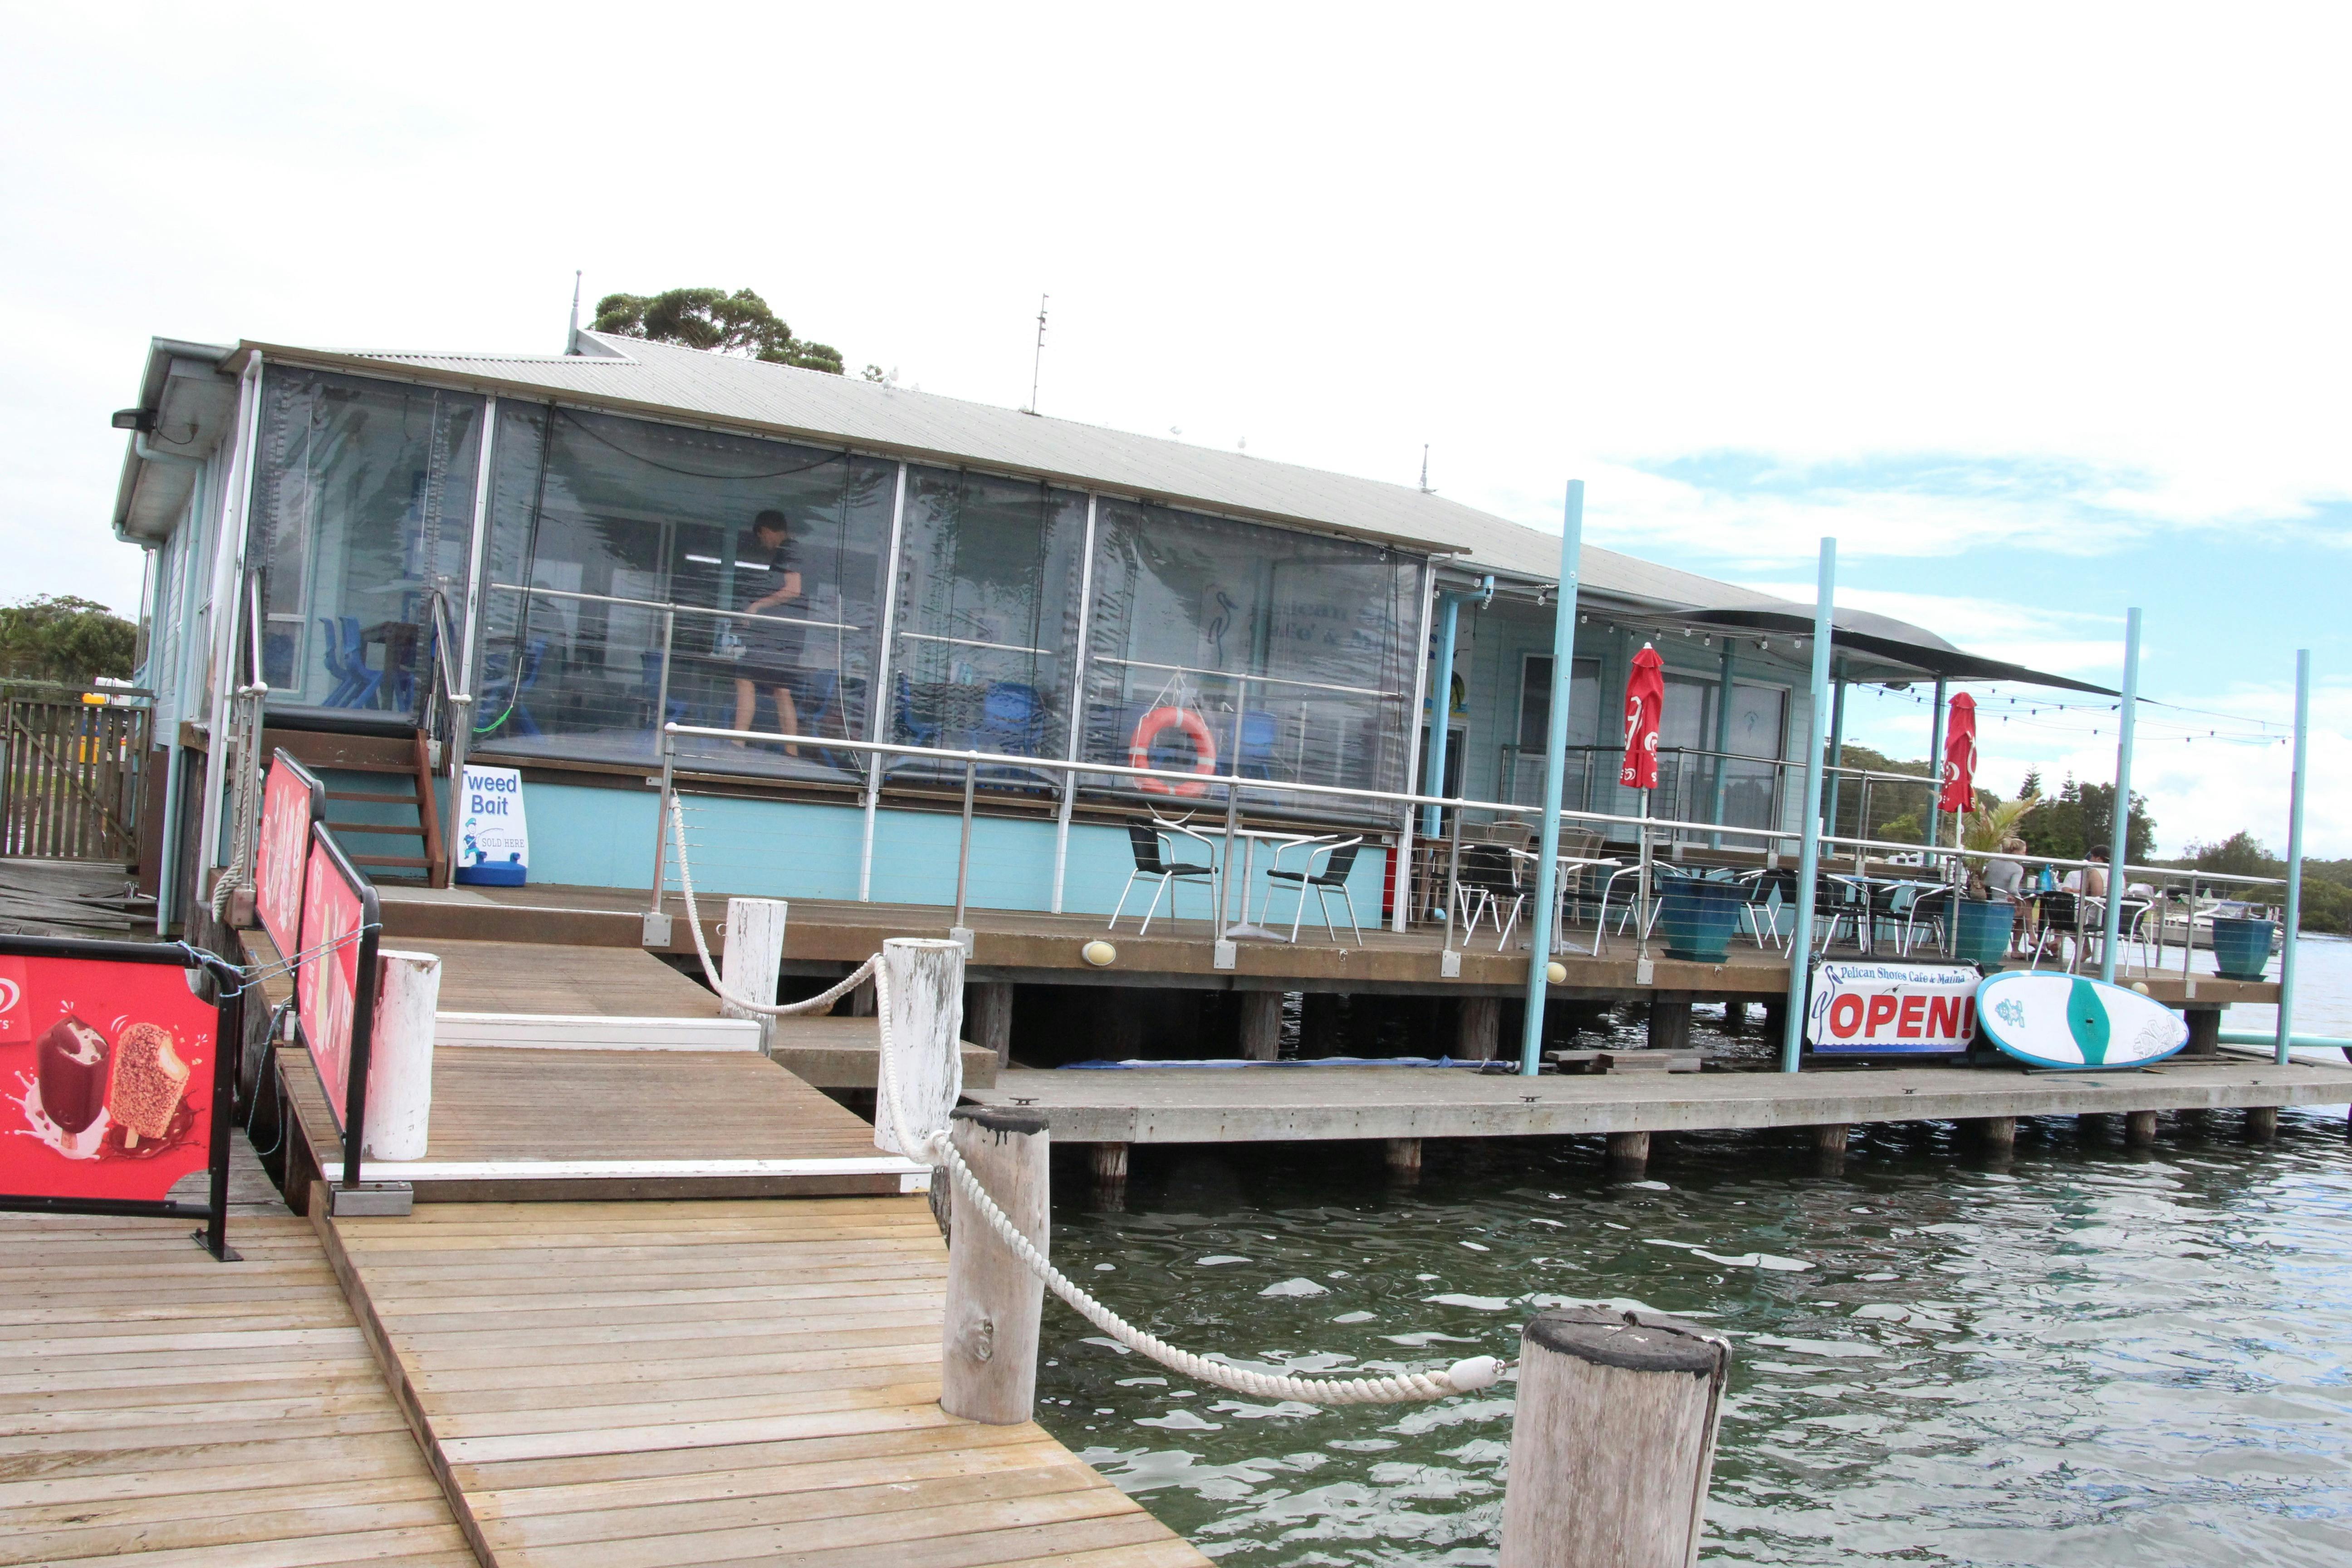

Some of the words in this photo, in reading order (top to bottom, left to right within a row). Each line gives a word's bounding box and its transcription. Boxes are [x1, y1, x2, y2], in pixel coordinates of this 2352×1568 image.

[471, 794, 508, 815] Bait
[482, 838, 501, 847] SOLD
[505, 839, 525, 848] HERE
[1840, 966, 1875, 979] Pelican
[1877, 967, 1907, 980] Shores
[1930, 974, 1935, 983] &
[1937, 970, 1965, 984] Marina
[1830, 993, 1975, 1039] OPEN!
